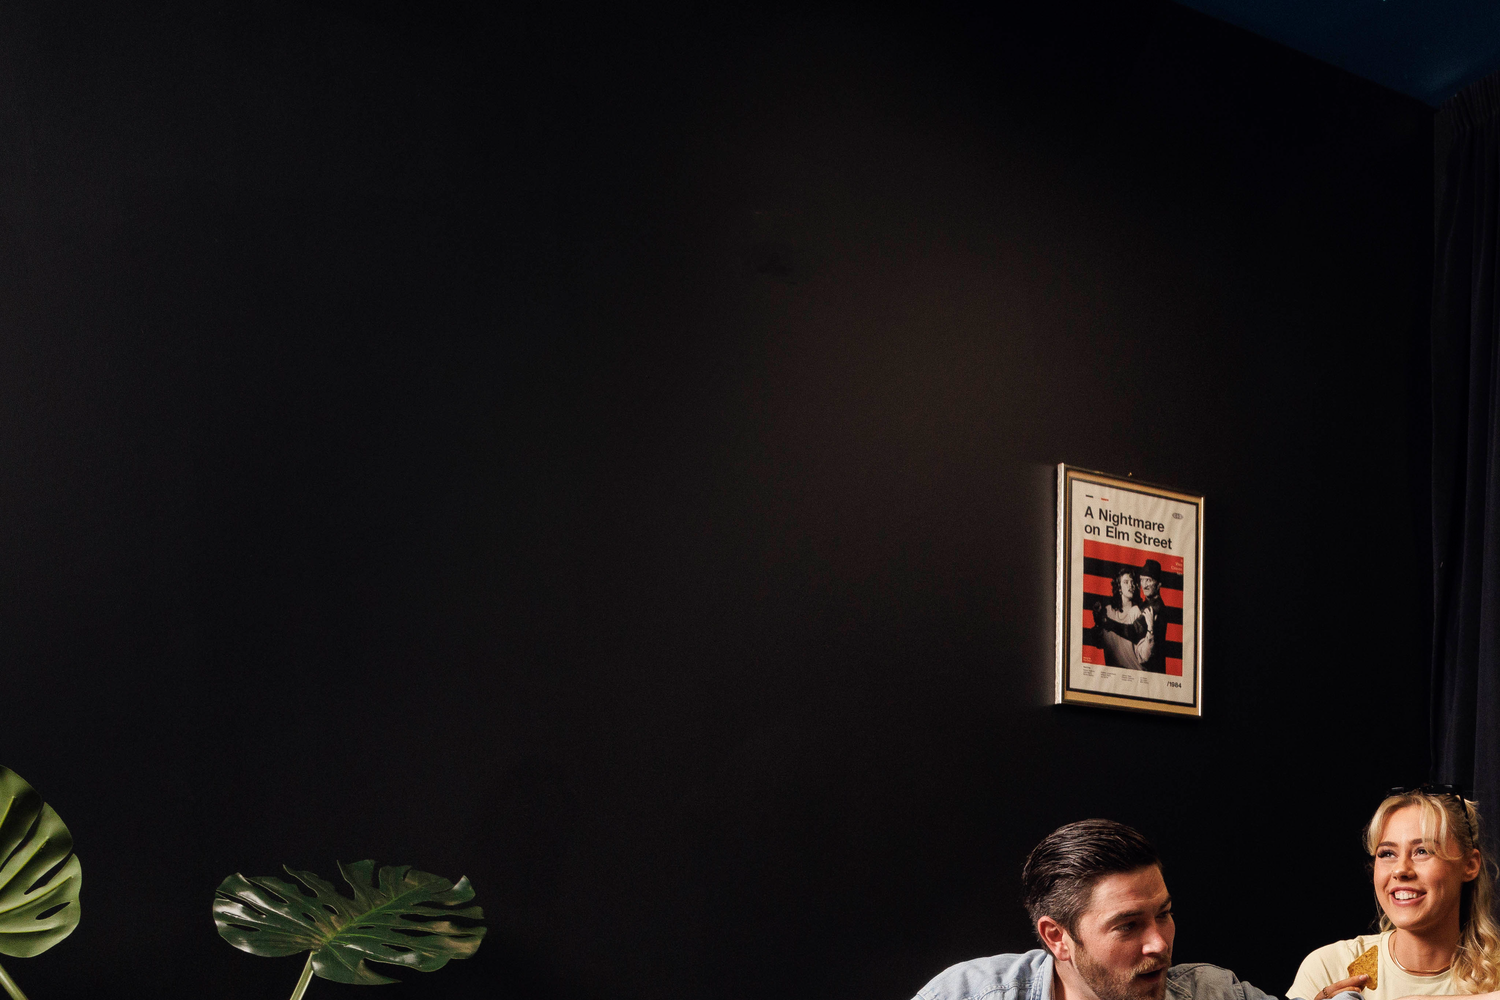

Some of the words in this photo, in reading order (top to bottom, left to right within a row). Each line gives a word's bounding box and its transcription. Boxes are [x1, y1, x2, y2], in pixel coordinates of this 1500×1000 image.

[1084, 506, 1094, 519] A
[1099, 508, 1165, 532] Nightmare
[1084, 524, 1100, 536] on
[1106, 525, 1129, 541] Elm
[1134, 531, 1172, 550] Street
